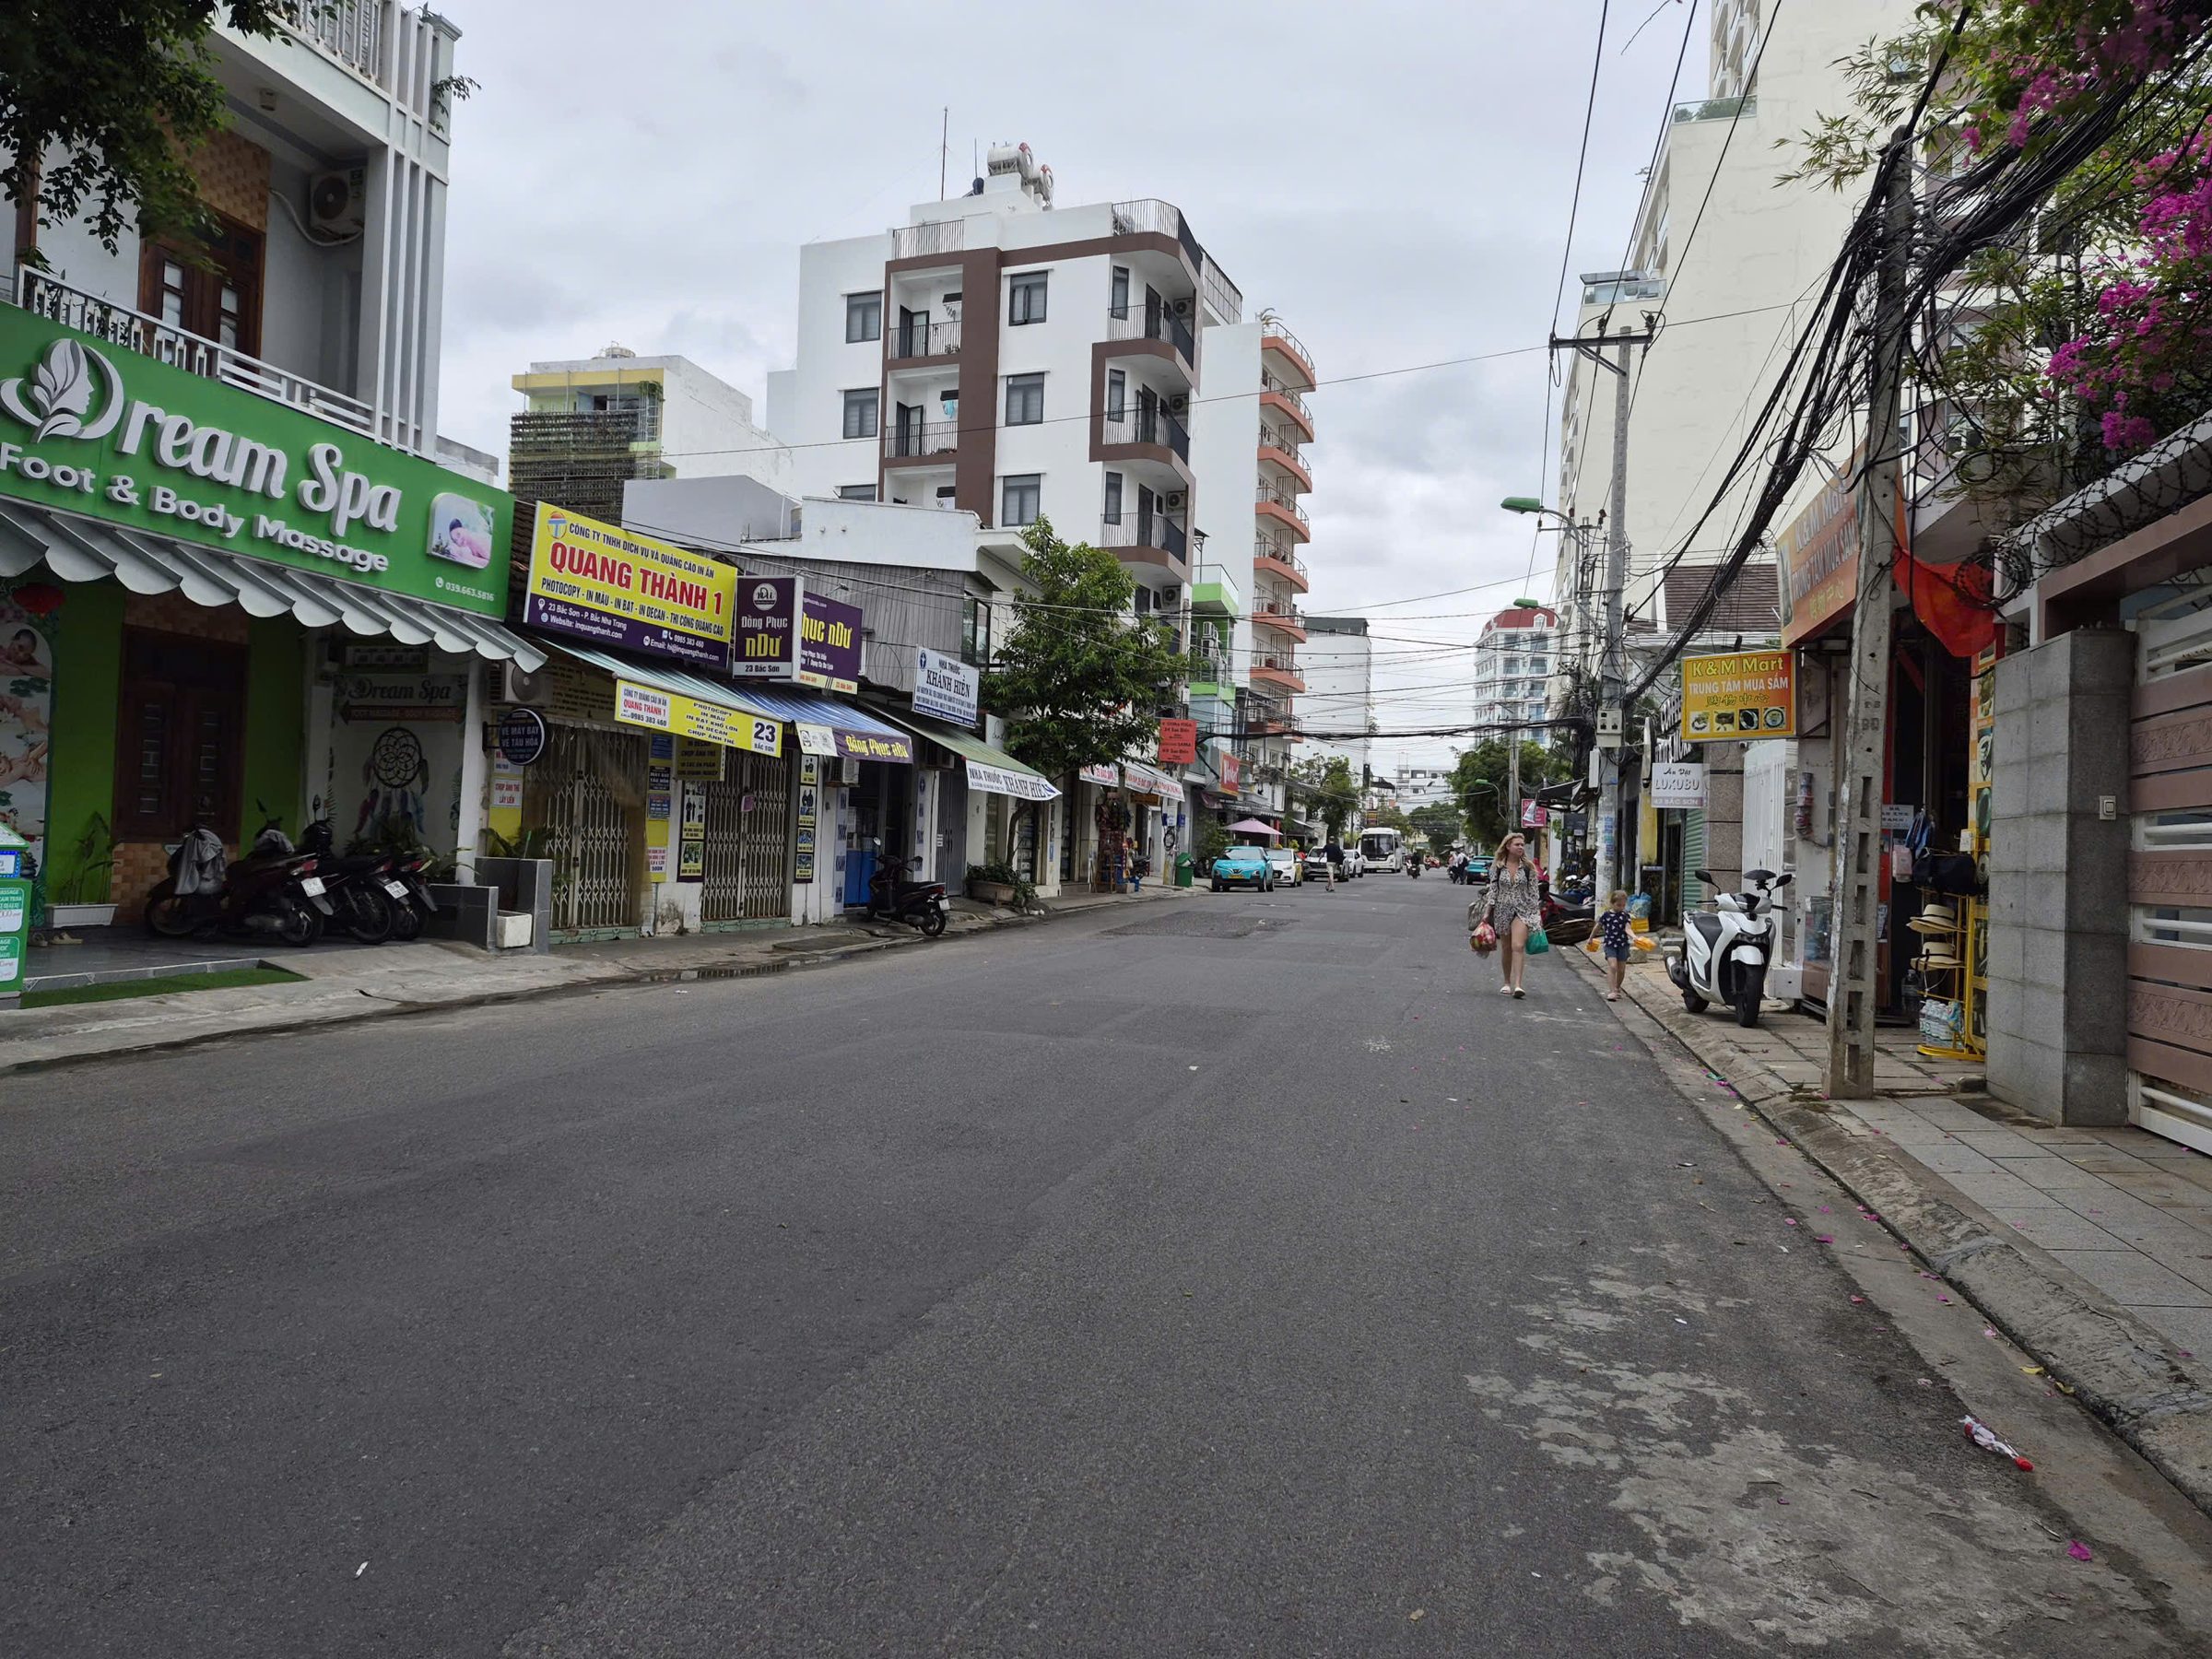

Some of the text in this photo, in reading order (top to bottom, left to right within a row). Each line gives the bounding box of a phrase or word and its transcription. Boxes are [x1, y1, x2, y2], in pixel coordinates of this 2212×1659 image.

[298, 443, 402, 536] Spa
[0, 442, 389, 573] Foot & Body Massage
[570, 523, 590, 538] CÔNG
[592, 530, 601, 542] TY
[603, 534, 621, 548] TNHH
[550, 542, 723, 616] QUANG THÀNH 1
[541, 578, 581, 598] PHOTOCOPY
[586, 590, 594, 602] IN
[615, 597, 622, 609] IN
[741, 615, 788, 630] Đồng Phục
[802, 612, 853, 650] hục nDư
[746, 633, 782, 657] nDư
[746, 665, 780, 673] 23 Bắc Sơn
[1742, 657, 1783, 673] Mart
[418, 680, 452, 703] Spa
[926, 669, 953, 692] KHÁNH
[1688, 673, 1789, 695] TRUNG TÂM MUA SẮM
[623, 699, 643, 712] QUANG
[693, 701, 733, 717] PHOTOCOPY
[753, 722, 776, 743] 23
[845, 734, 869, 757] Đồng
[869, 738, 890, 759] Phục
[1003, 773, 1030, 796] KHÁNH
